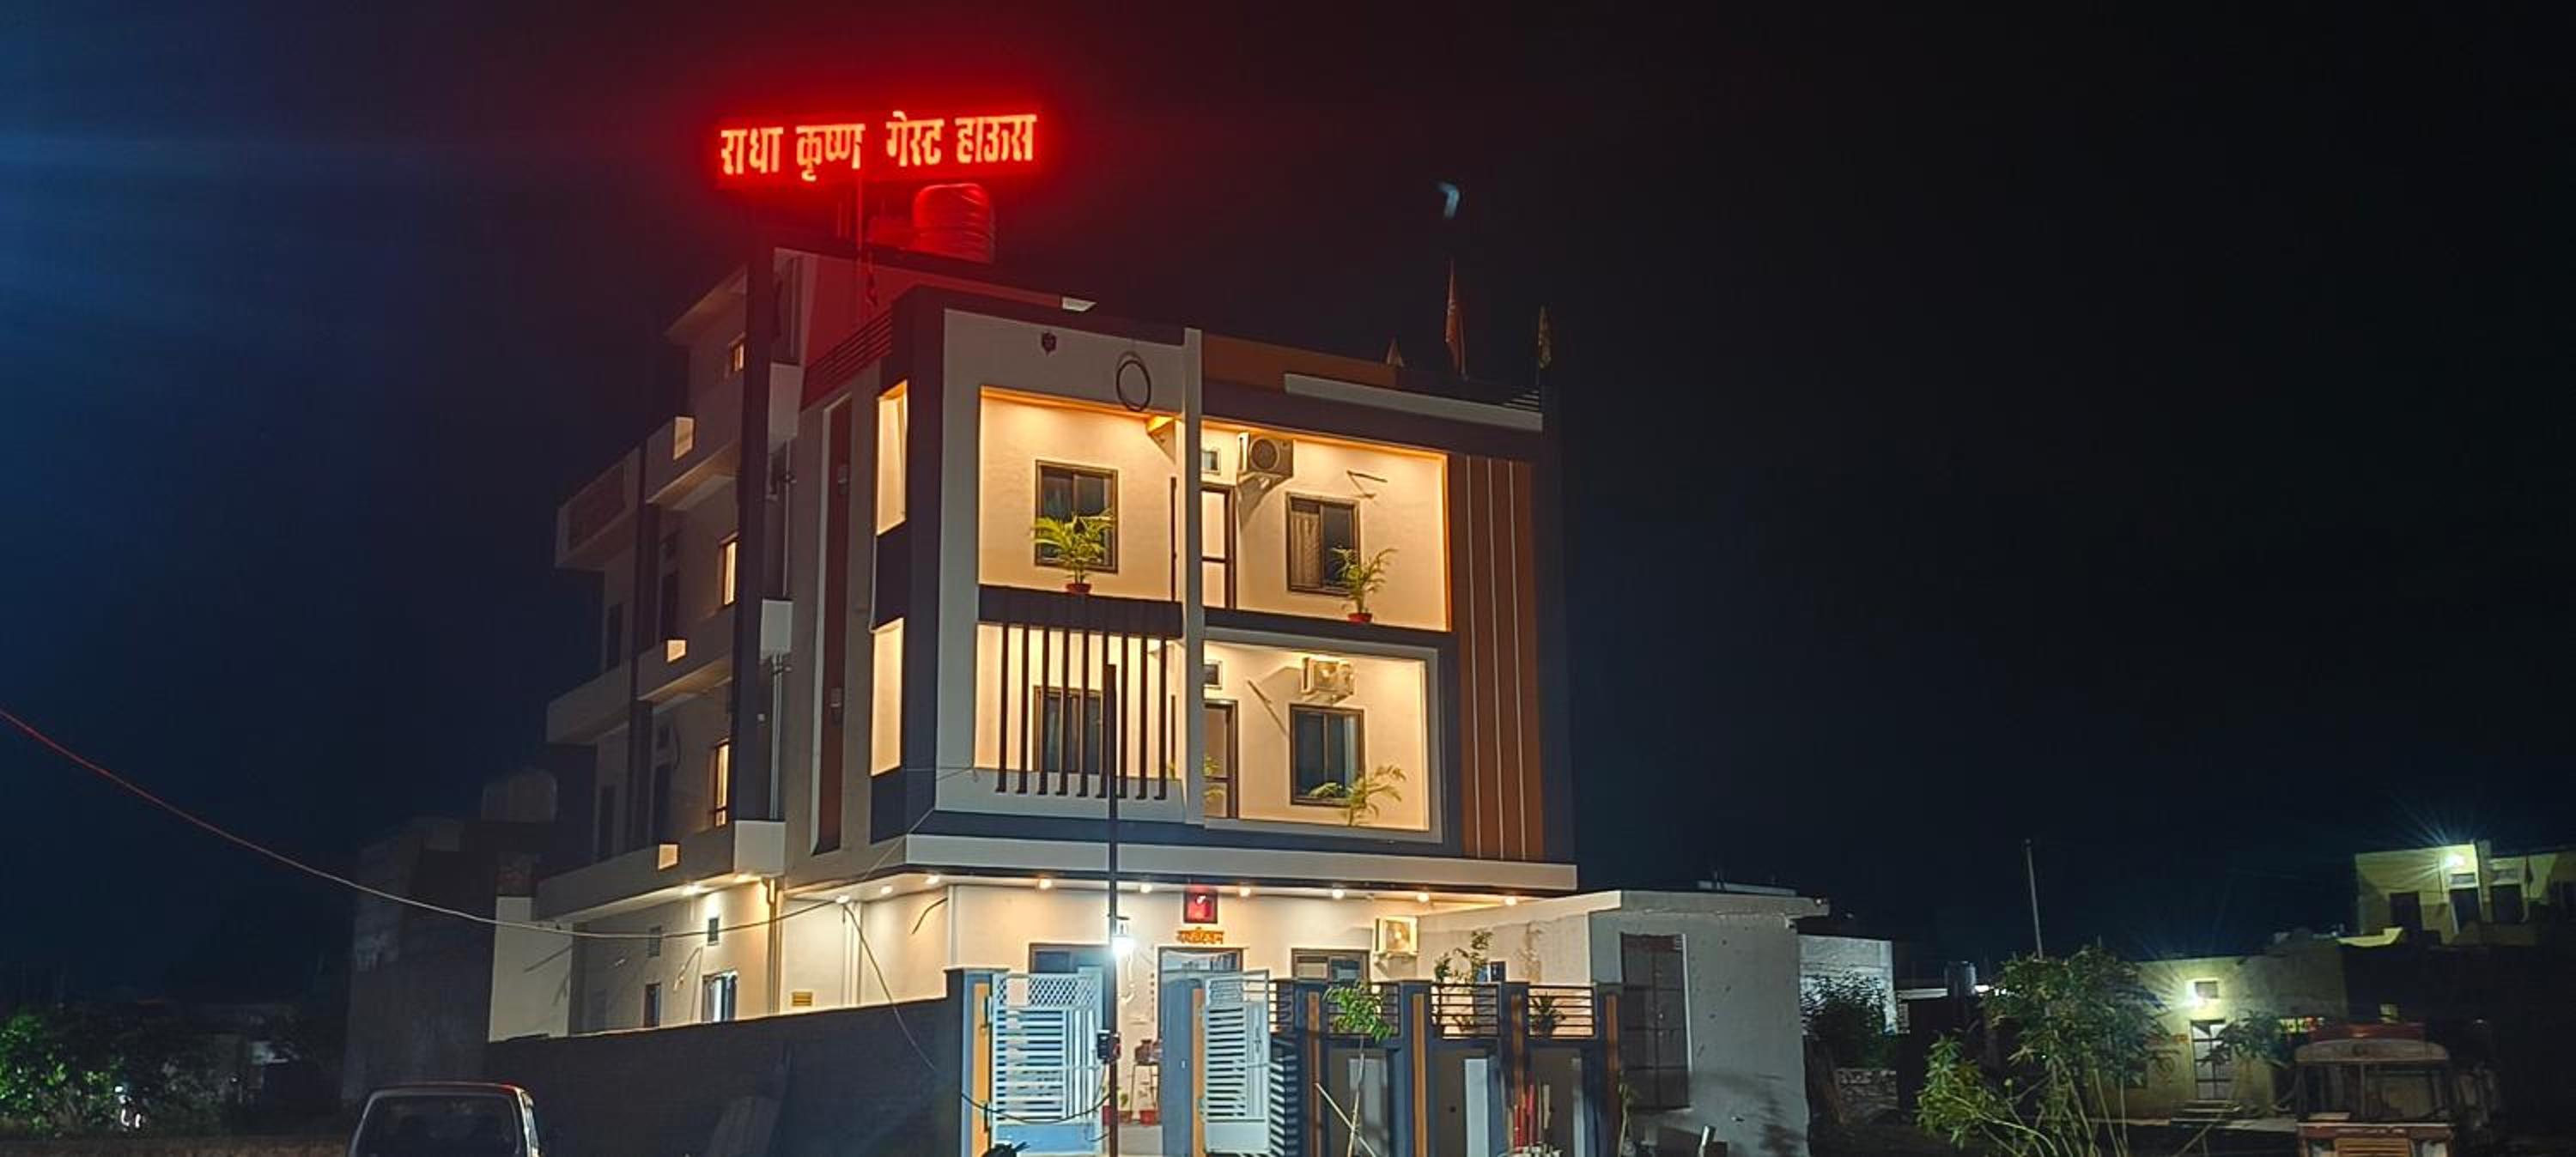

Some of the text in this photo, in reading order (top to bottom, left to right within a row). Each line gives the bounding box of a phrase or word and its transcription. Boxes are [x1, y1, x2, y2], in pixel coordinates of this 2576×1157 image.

[721, 111, 1037, 181] राधा कृष्ण गेस्ट हाऊस
